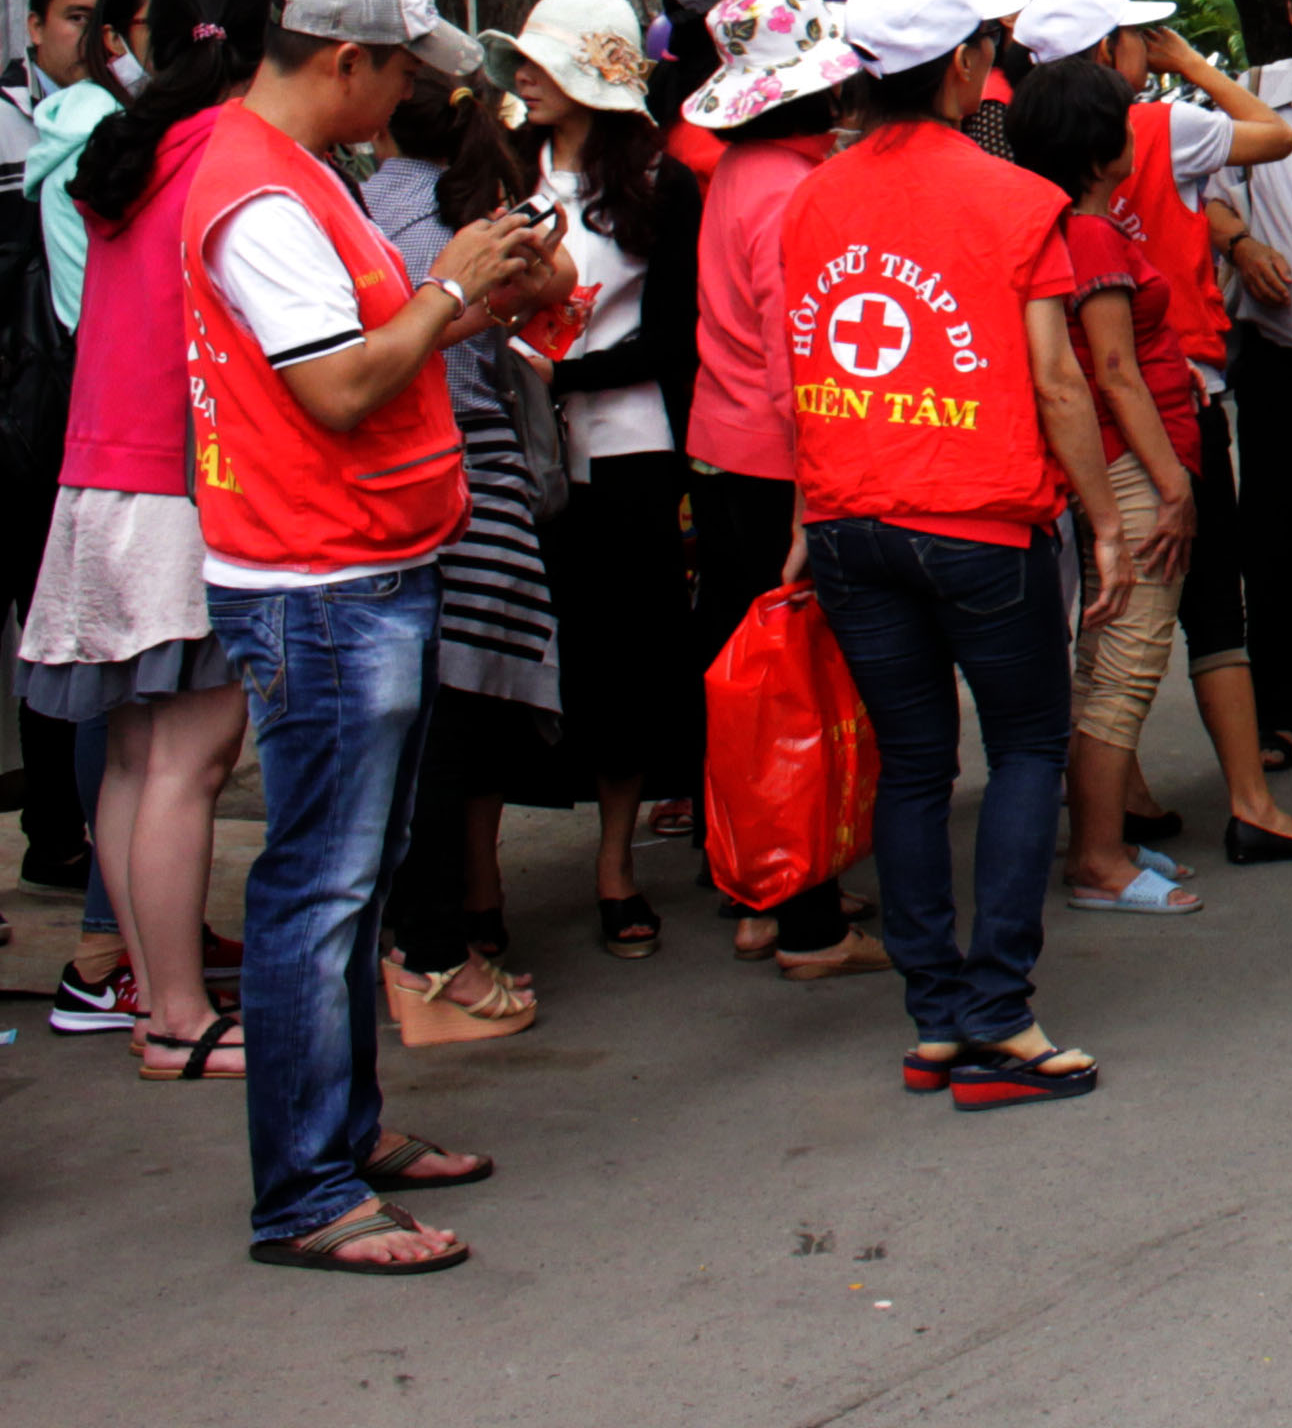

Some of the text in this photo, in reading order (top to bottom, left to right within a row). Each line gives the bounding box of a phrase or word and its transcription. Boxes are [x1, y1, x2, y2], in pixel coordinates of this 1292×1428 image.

[880, 253, 959, 313] THẬP
[945, 321, 989, 373] ĐỎ
[884, 387, 981, 431] TÂM
